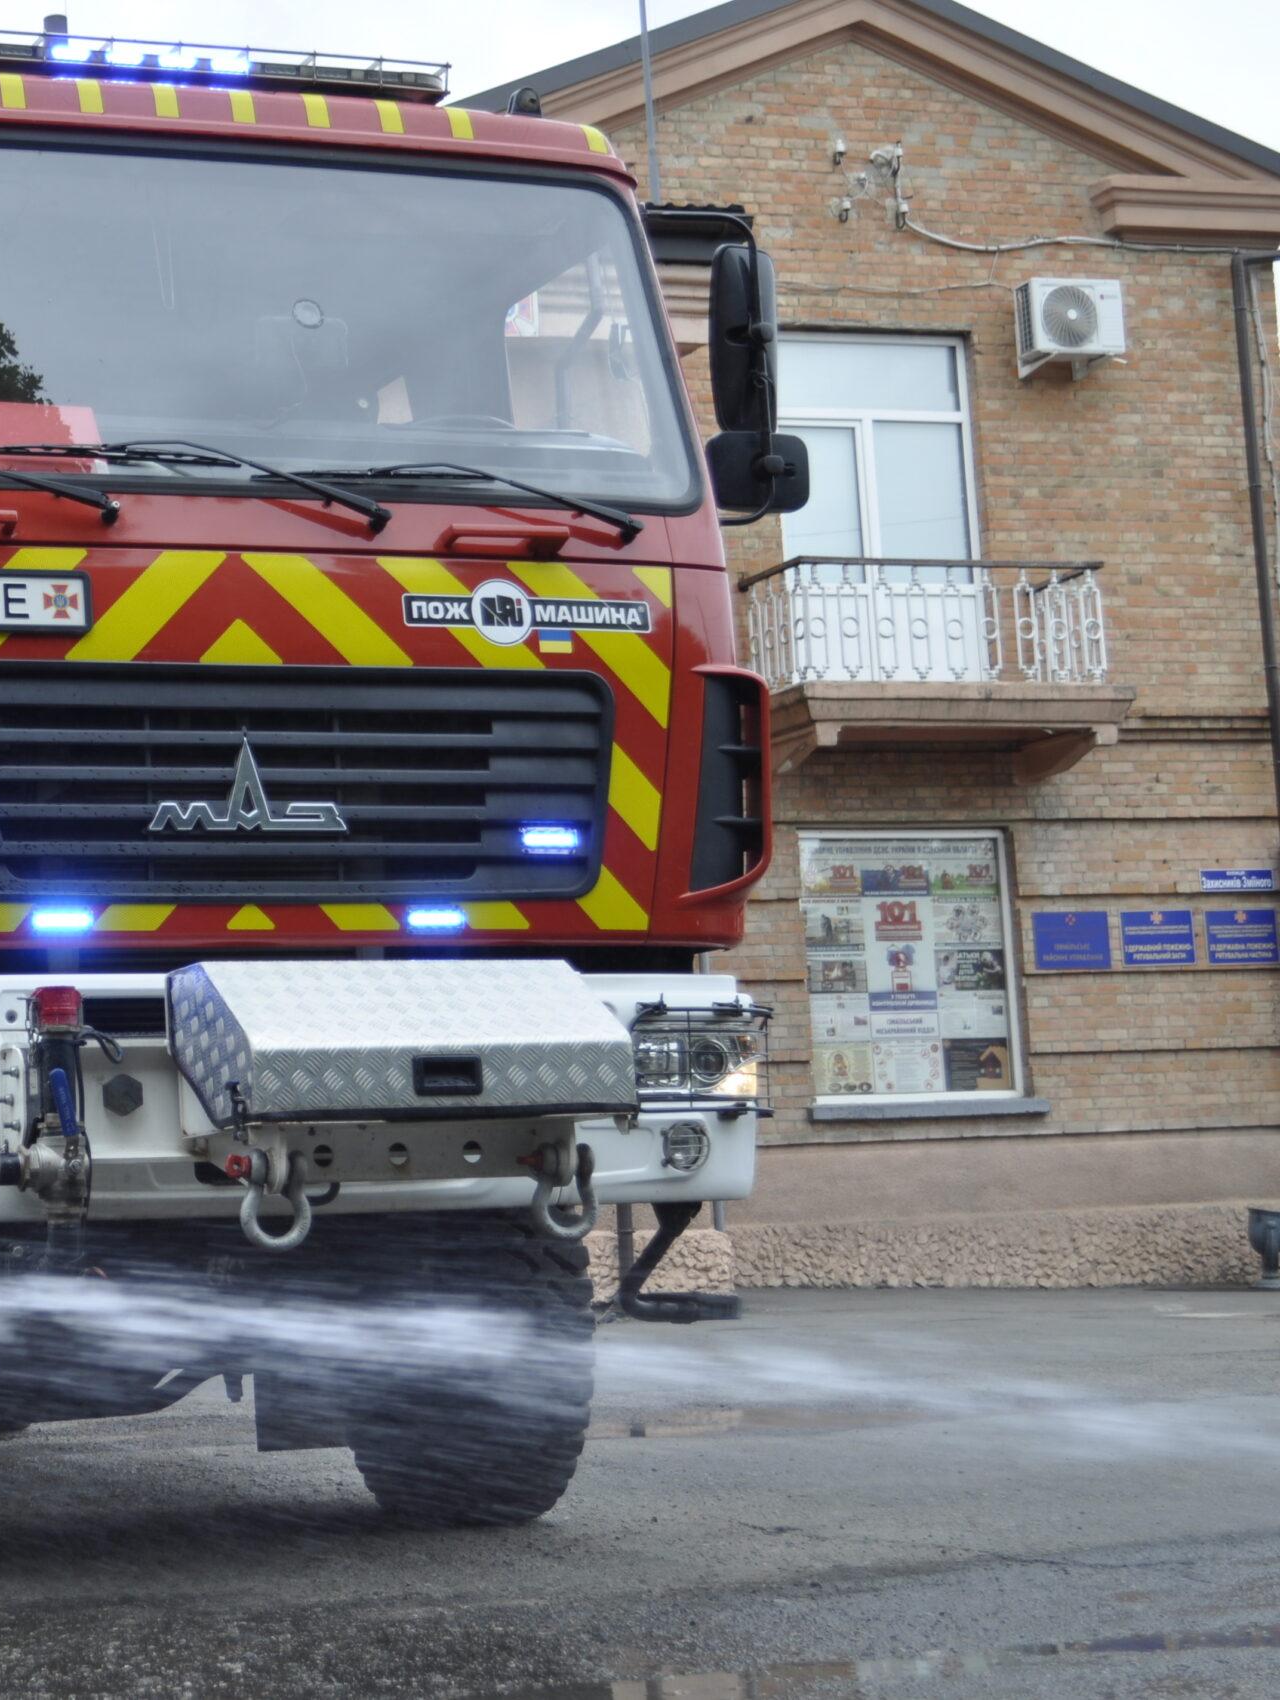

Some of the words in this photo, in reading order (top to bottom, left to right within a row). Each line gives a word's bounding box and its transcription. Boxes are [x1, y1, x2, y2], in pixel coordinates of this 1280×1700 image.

[3, 583, 30, 619] E
[411, 601, 469, 620] ПОЖ
[534, 604, 642, 626] МАШИНА
[876, 901, 917, 924] 101
